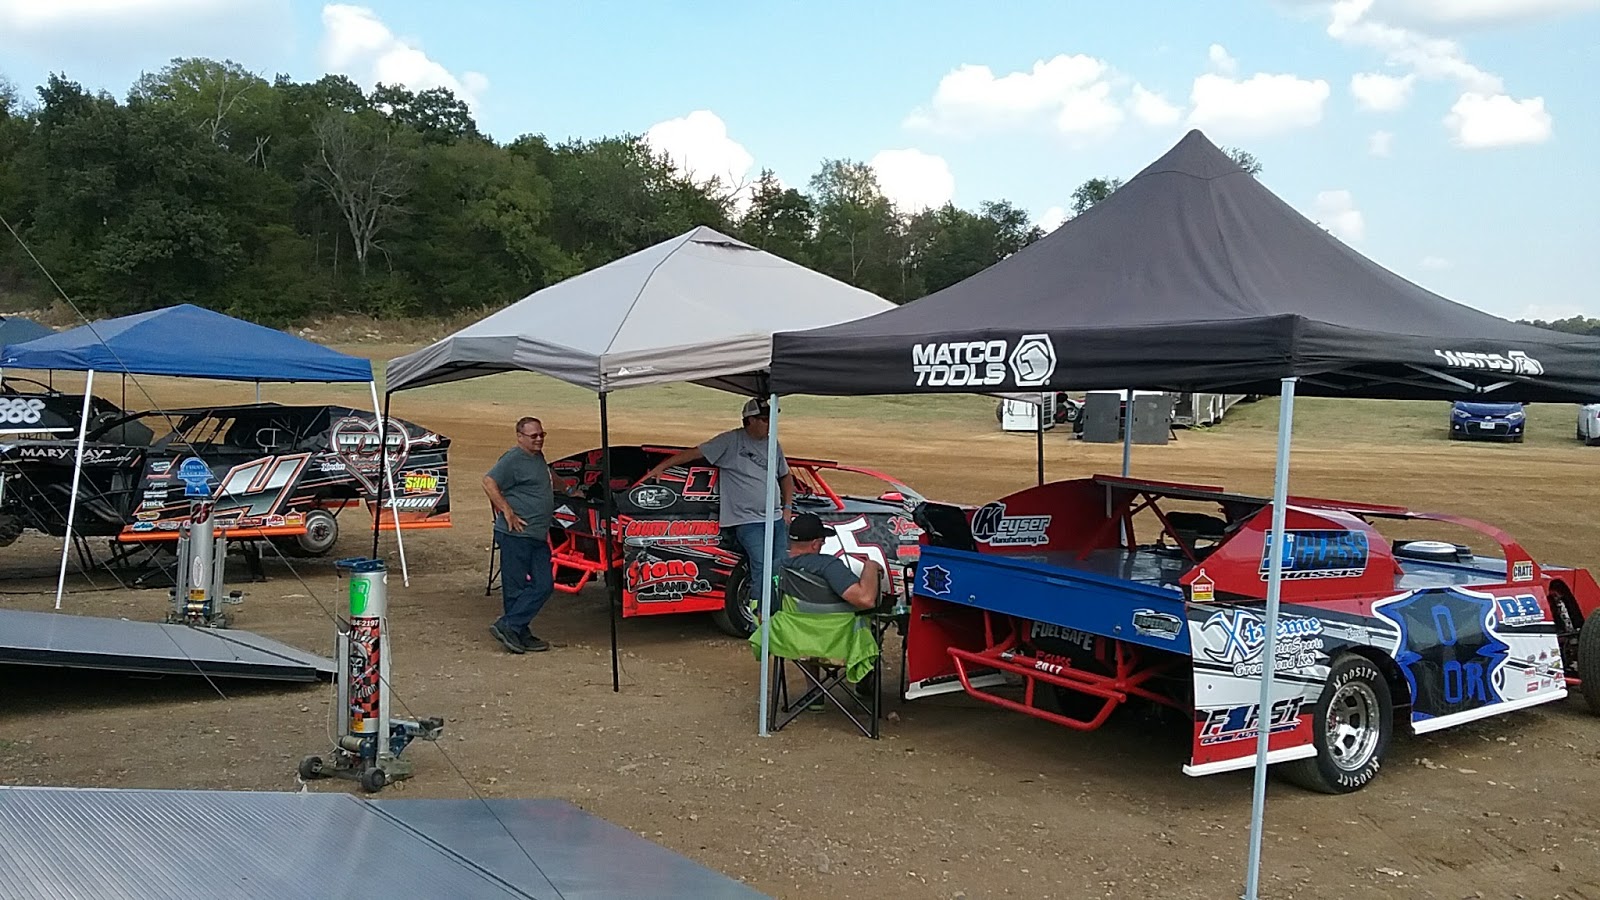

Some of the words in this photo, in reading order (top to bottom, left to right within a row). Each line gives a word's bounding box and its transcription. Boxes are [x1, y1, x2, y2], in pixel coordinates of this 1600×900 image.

[912, 340, 1007, 365] MATCO
[1434, 350, 1514, 370] MATCO
[913, 363, 1007, 386] TOOLS
[20, 448, 70, 459] MARY
[405, 477, 437, 489] SHAW
[626, 521, 669, 536] CAUSEY
[669, 521, 719, 536] COATINGS
[974, 506, 1050, 537] Keyser
[627, 560, 697, 588] Stone
[1513, 565, 1533, 578] CRATE
[656, 581, 689, 592] SAND
[691, 580, 711, 592] CO.
[1035, 660, 1063, 674] 2017
[1234, 661, 1263, 677] Grea
[1275, 653, 1295, 669] end
[1297, 652, 1317, 667] KS
